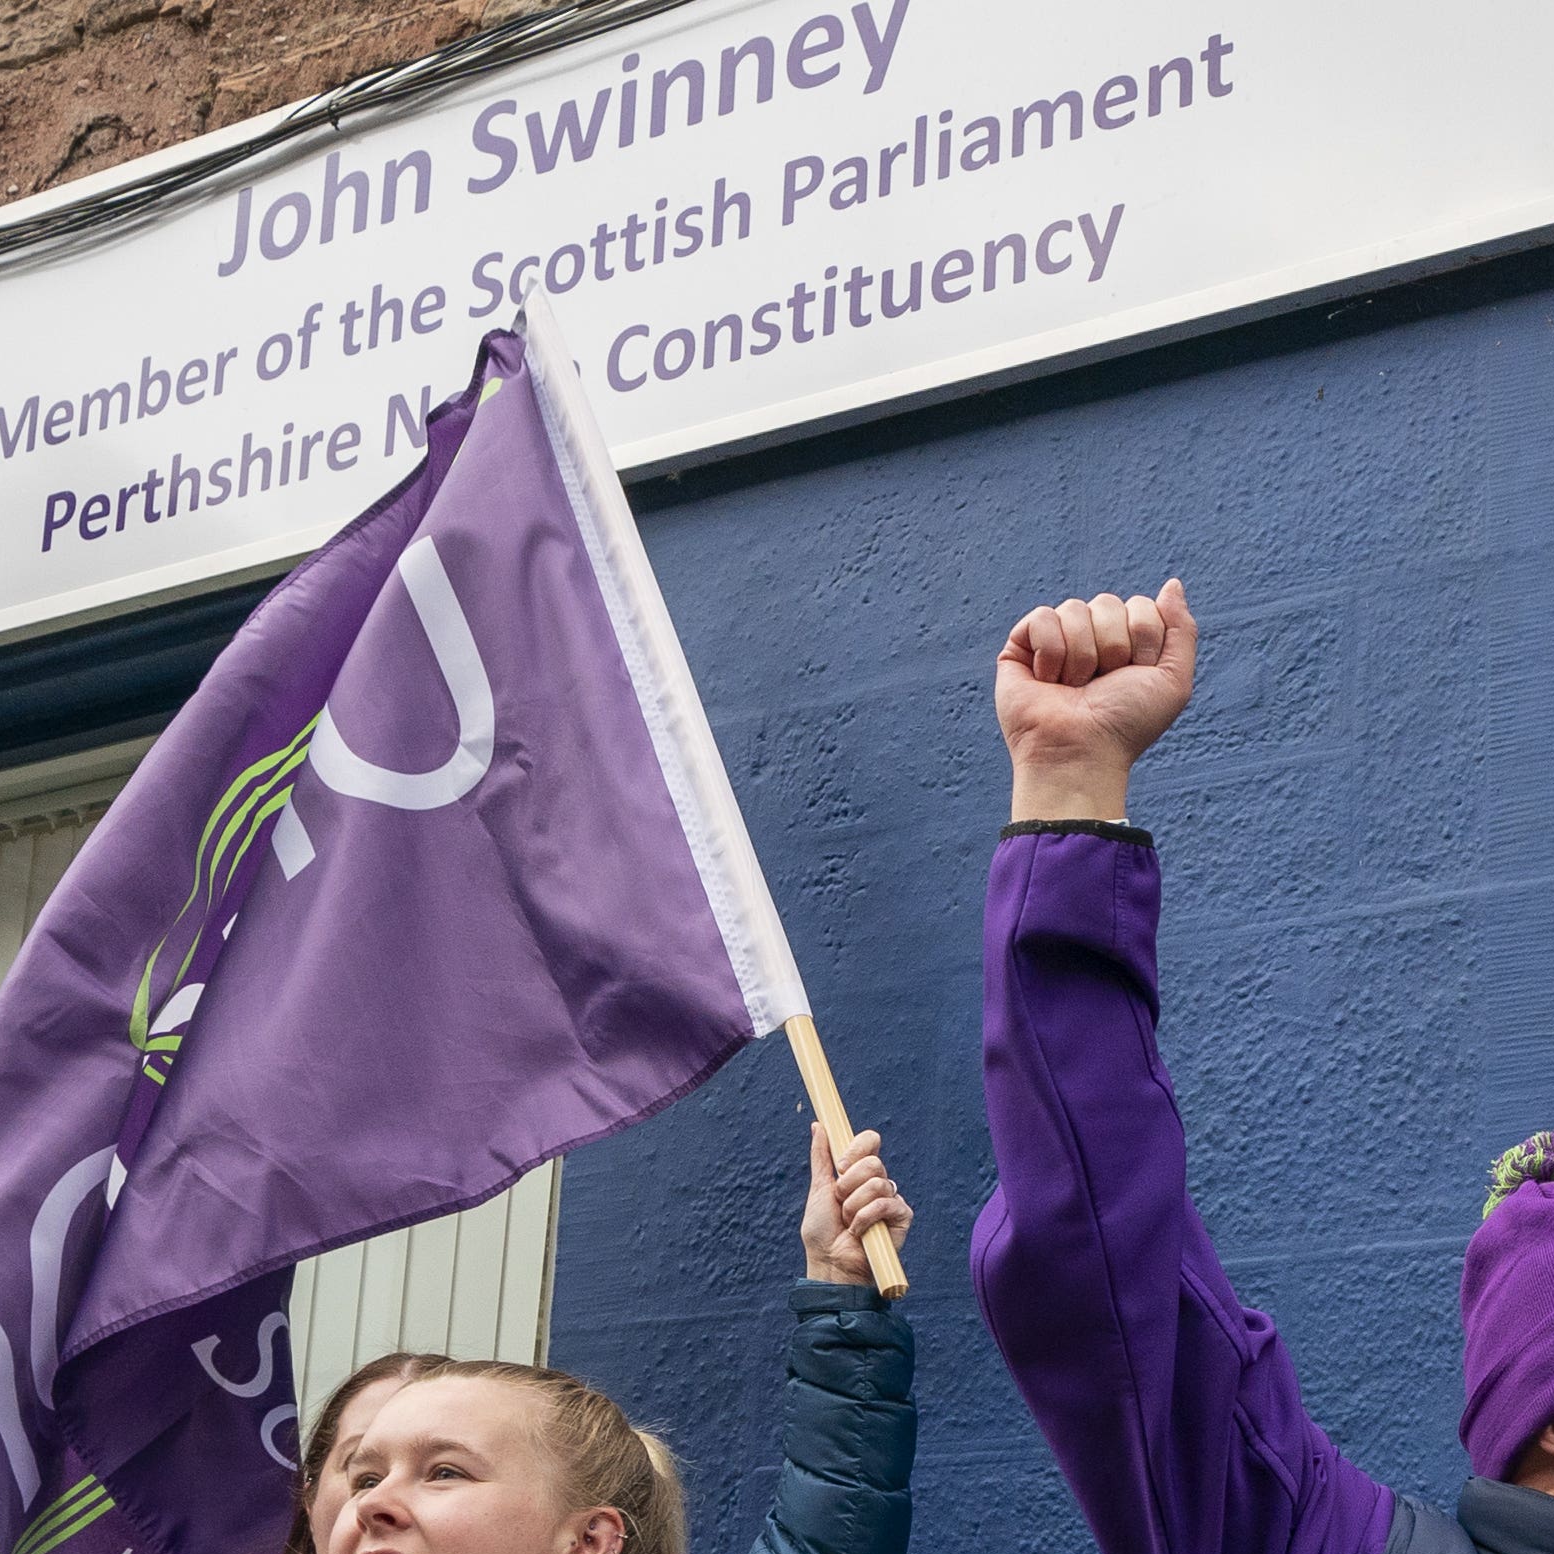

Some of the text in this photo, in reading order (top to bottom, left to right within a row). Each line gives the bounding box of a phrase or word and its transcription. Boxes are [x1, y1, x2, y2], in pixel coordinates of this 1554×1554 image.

[218, 0, 910, 277] John Swinney
[256, 302, 324, 381] of
[341, 284, 447, 356] the
[469, 179, 750, 318] Scottish
[781, 33, 1234, 226] Parliament
[41, 421, 362, 552] Perthshire
[607, 203, 1125, 393] Constituency
